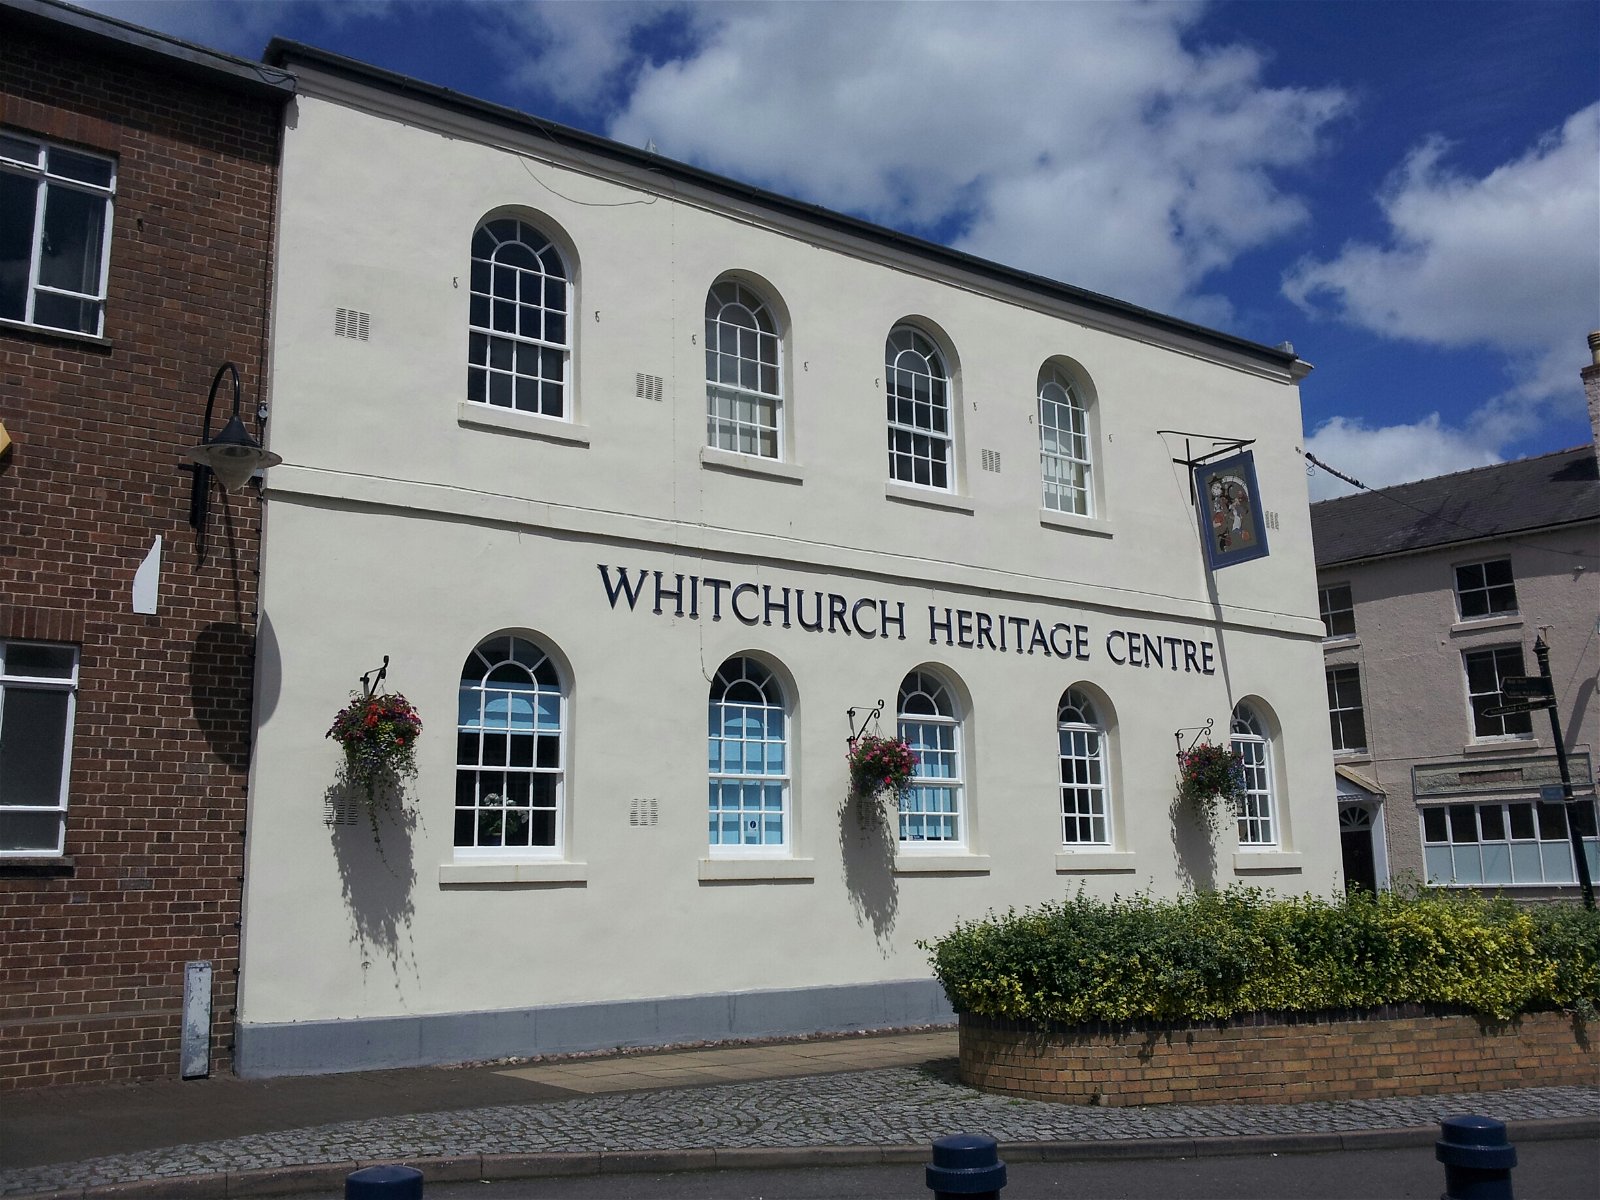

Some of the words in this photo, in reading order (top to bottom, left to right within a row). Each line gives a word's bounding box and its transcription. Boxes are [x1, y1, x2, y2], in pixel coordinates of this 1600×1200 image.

[597, 564, 907, 641] WHITCHURCH
[929, 606, 1090, 661] HERITAGE
[1107, 631, 1216, 676] CENTRE
